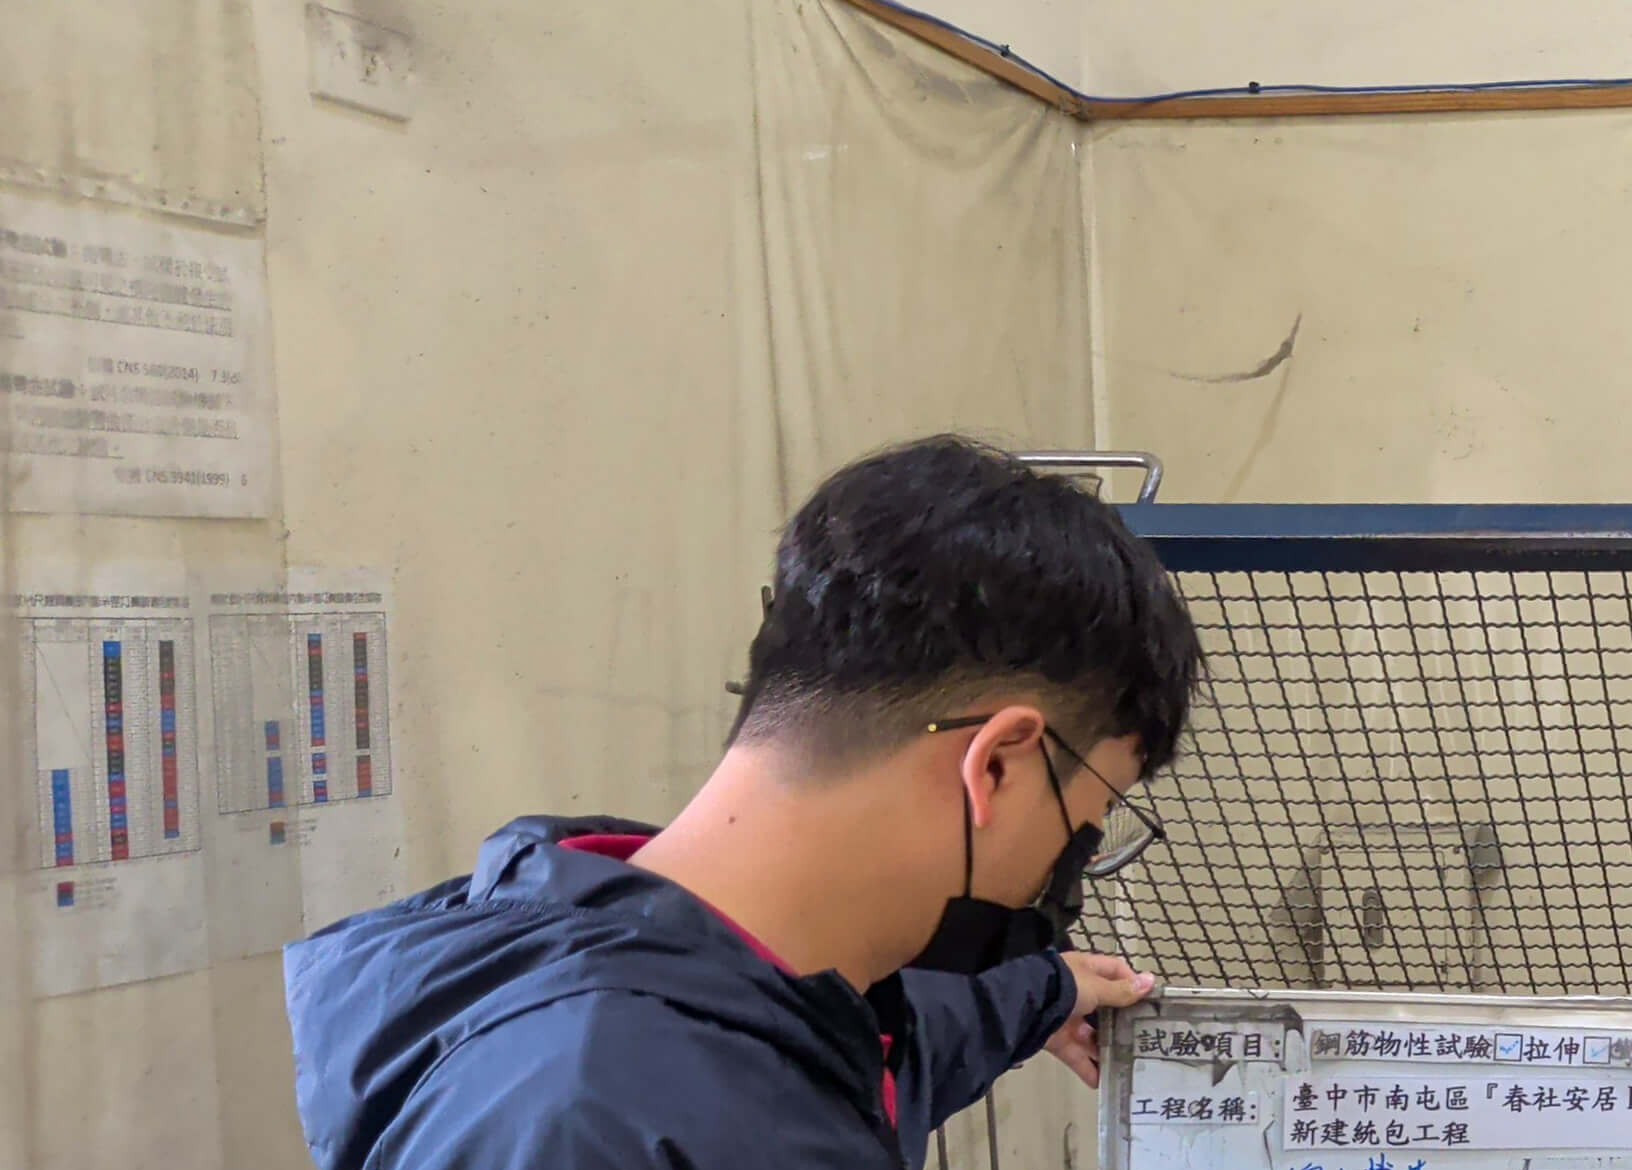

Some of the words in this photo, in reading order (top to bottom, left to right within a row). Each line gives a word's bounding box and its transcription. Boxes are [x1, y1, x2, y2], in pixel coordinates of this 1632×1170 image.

[1312, 1030, 1493, 1060] 鋼筋物性試驗
[1523, 1036, 1581, 1063] 拉伸
[1290, 1118, 1470, 1146] 新建統包工程
